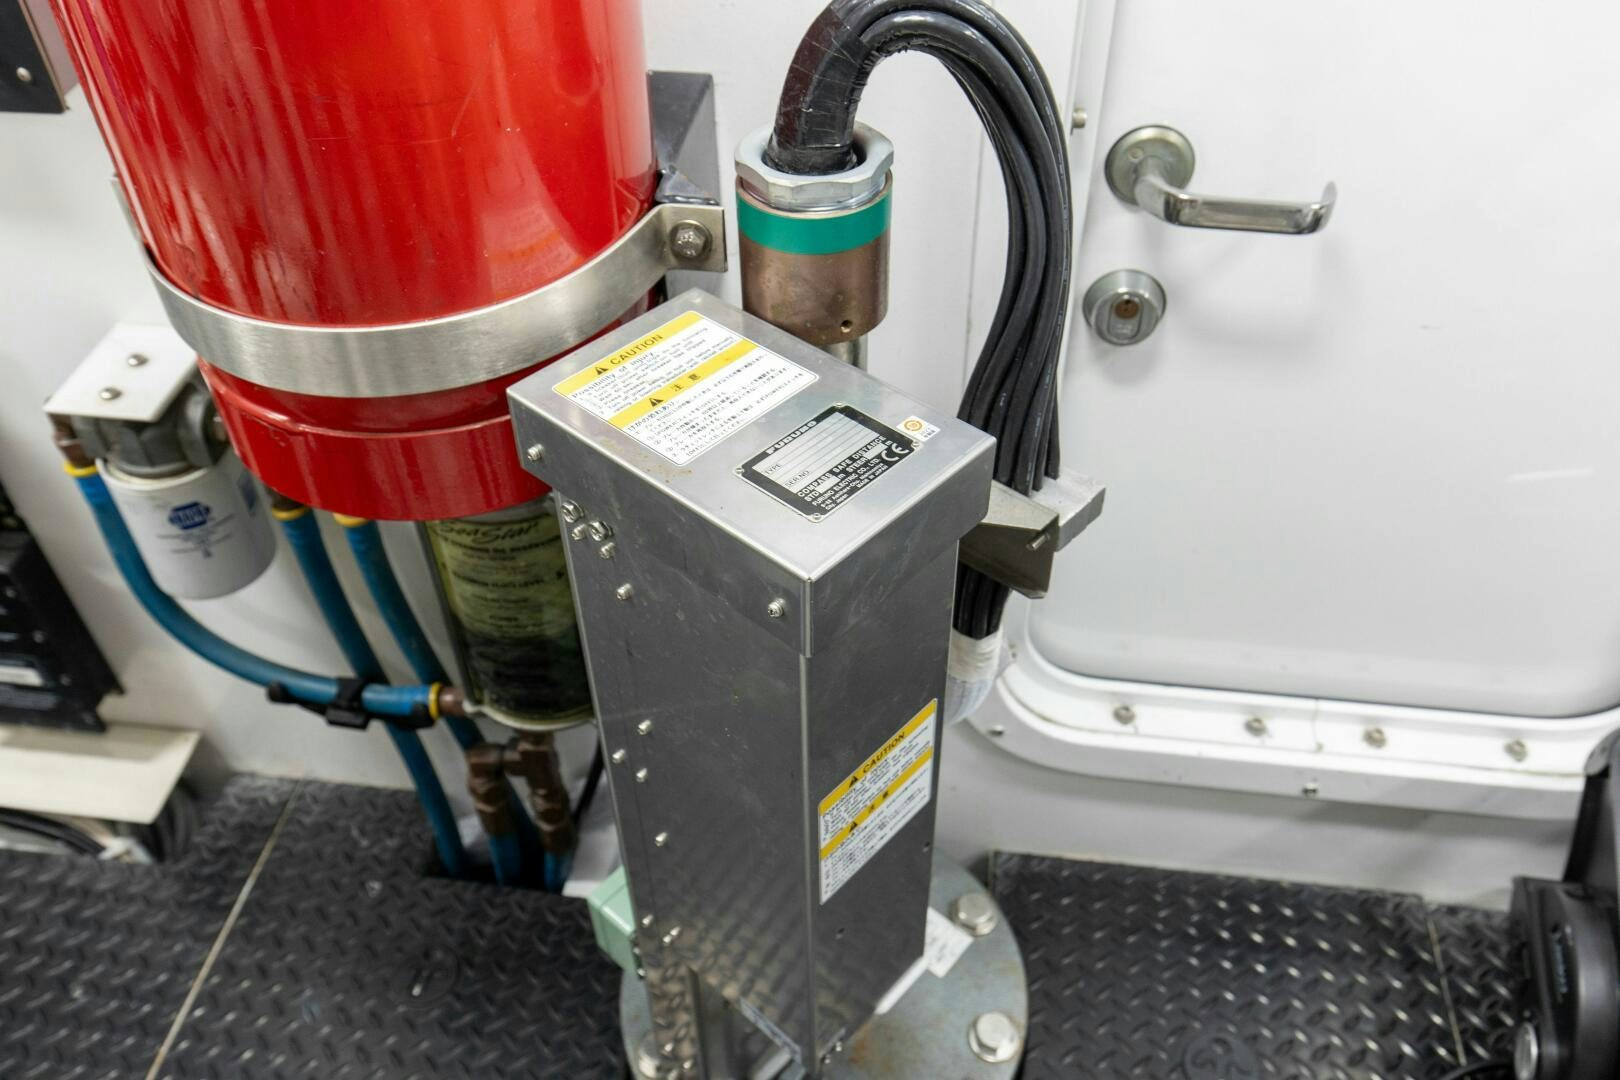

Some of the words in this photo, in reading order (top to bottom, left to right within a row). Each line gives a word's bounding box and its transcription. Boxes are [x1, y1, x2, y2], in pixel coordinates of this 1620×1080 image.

[610, 334, 663, 365] CAUTION
[766, 421, 817, 455] FURUNO
[765, 464, 781, 474] TYPE
[797, 473, 832, 497] COMPASS
[833, 459, 852, 473] SAFE
[854, 436, 887, 460] DISTANCE
[874, 465, 888, 476] JAPAN
[812, 489, 834, 507] FURUNO
[834, 473, 858, 490] ELECTRIC
[863, 732, 905, 773] CAUTION
